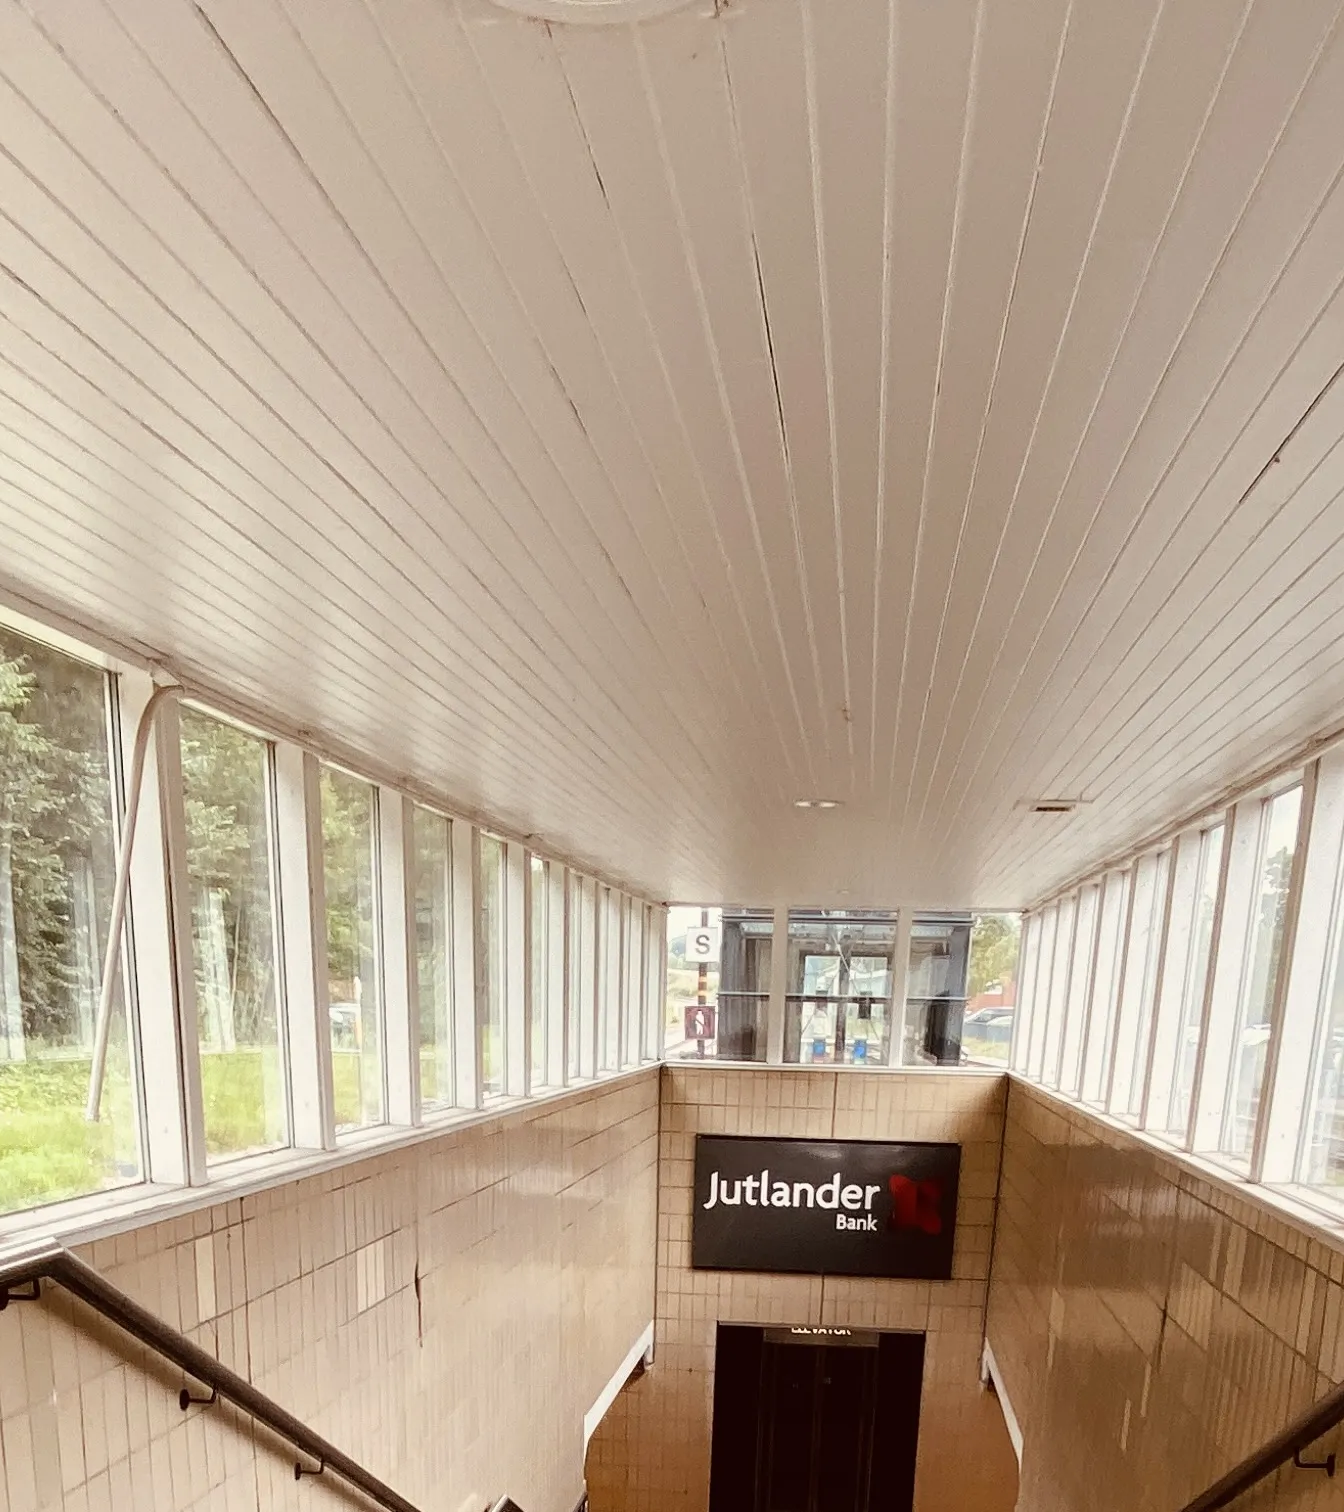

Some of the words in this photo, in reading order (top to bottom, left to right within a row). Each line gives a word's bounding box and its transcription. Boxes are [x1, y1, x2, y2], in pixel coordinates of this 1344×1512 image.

[695, 934, 710, 955] S
[703, 1169, 881, 1210] Jutlander
[836, 1213, 878, 1232] Bank
